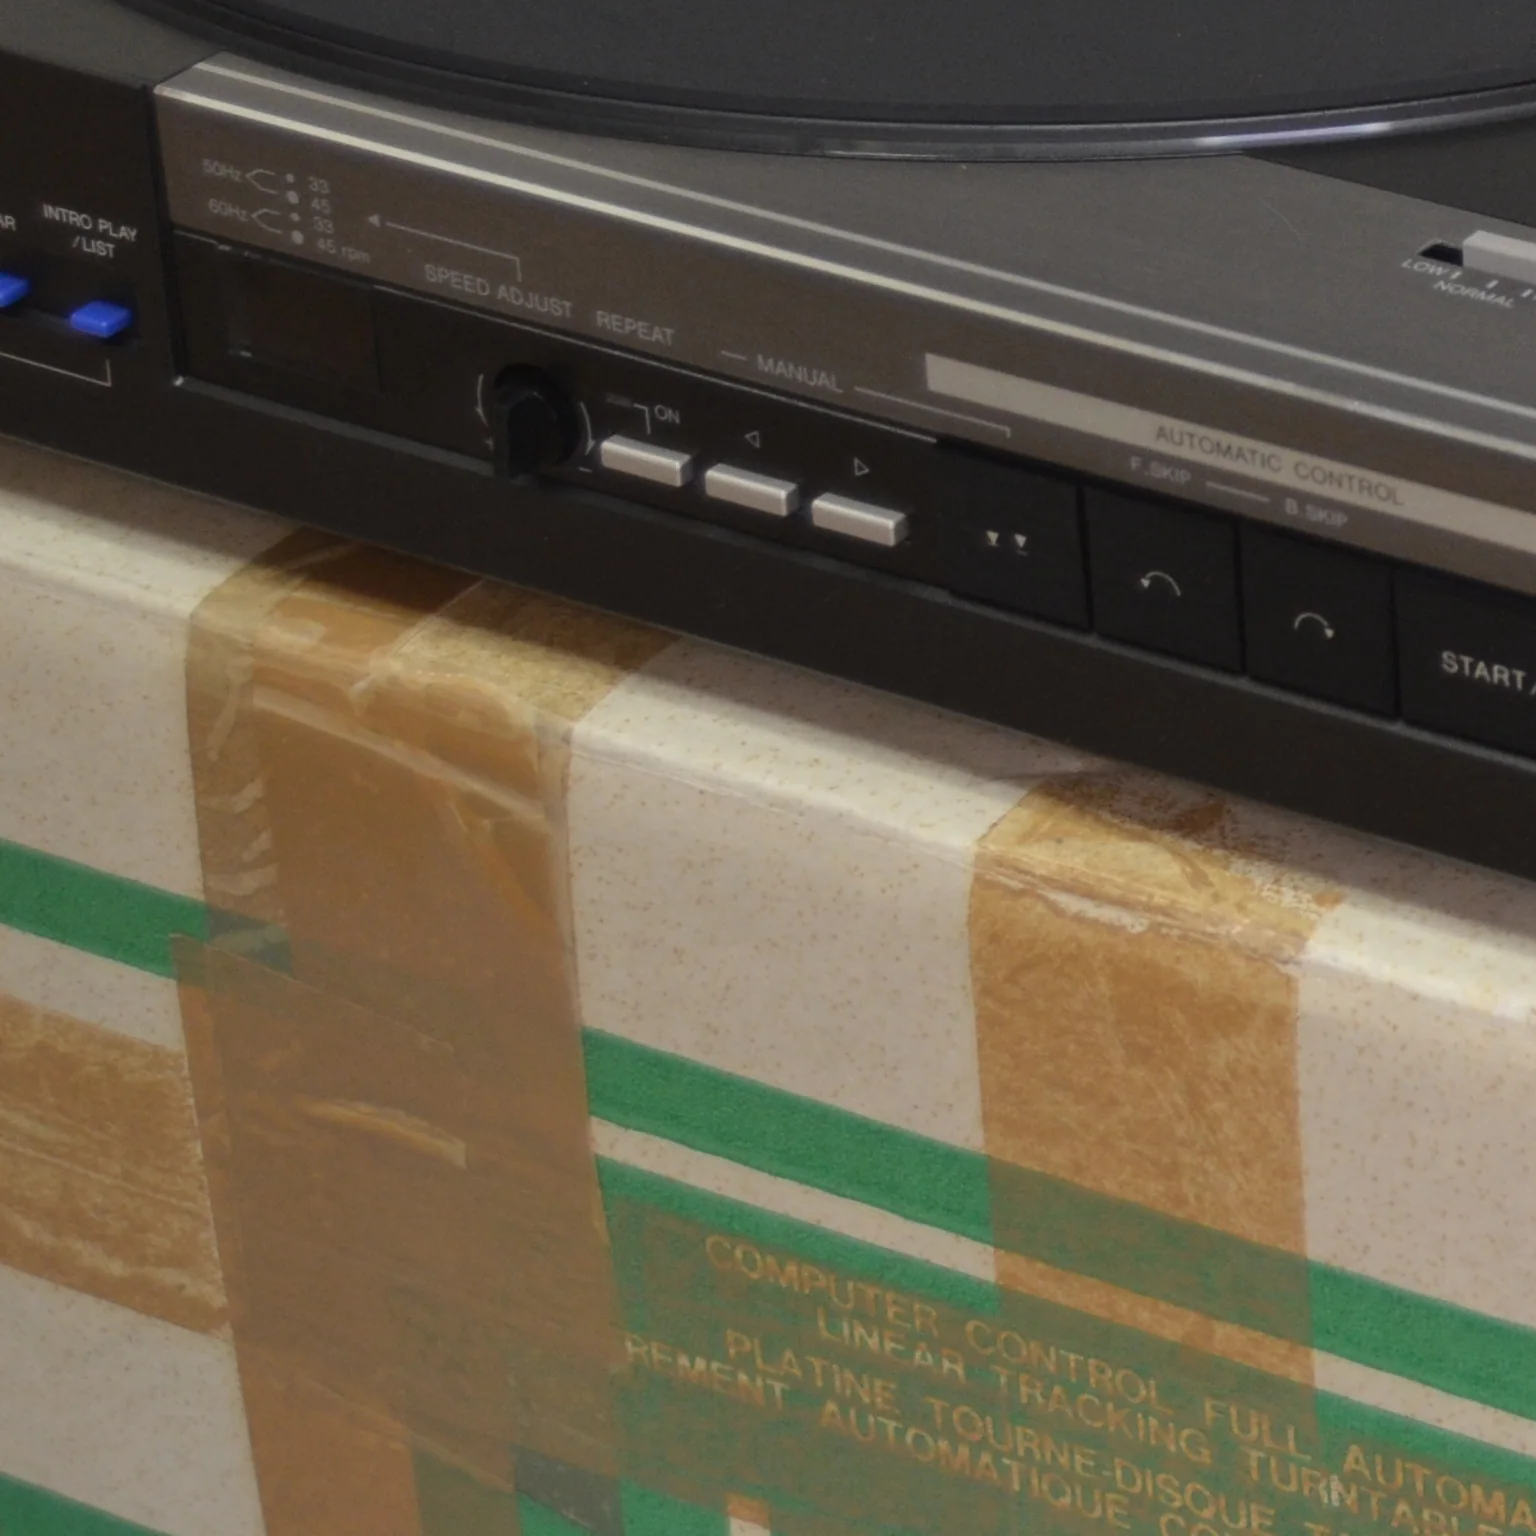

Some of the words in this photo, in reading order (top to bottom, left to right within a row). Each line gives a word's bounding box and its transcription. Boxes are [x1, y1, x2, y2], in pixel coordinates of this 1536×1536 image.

[307, 176, 331, 195] 33
[42, 202, 93, 231] INTRO
[97, 217, 138, 242] PLAY
[312, 216, 334, 235] 33
[72, 235, 115, 259] /LIST
[1400, 258, 1450, 277] LOW
[423, 263, 491, 298] SPEED
[496, 283, 574, 319] ADJUST
[1433, 279, 1516, 310] NORMAL
[595, 309, 676, 348] REPEAT
[755, 352, 845, 396] MANUAL
[653, 403, 682, 425] ON
[1154, 422, 1283, 476] AUTOMATIC
[1293, 459, 1406, 508] CONTROL
[704, 1234, 940, 1339] COMPUTER
[963, 1319, 1175, 1417] CONTROL
[1203, 1398, 1313, 1462] FULL
[815, 1306, 967, 1385] LINEAR
[990, 1362, 1213, 1466] TRACKING
[724, 1328, 899, 1415] PLATINE
[922, 1394, 1277, 1532] TOURNE-DISQUE
[819, 1398, 1132, 1532] AUTOMATIQUE
